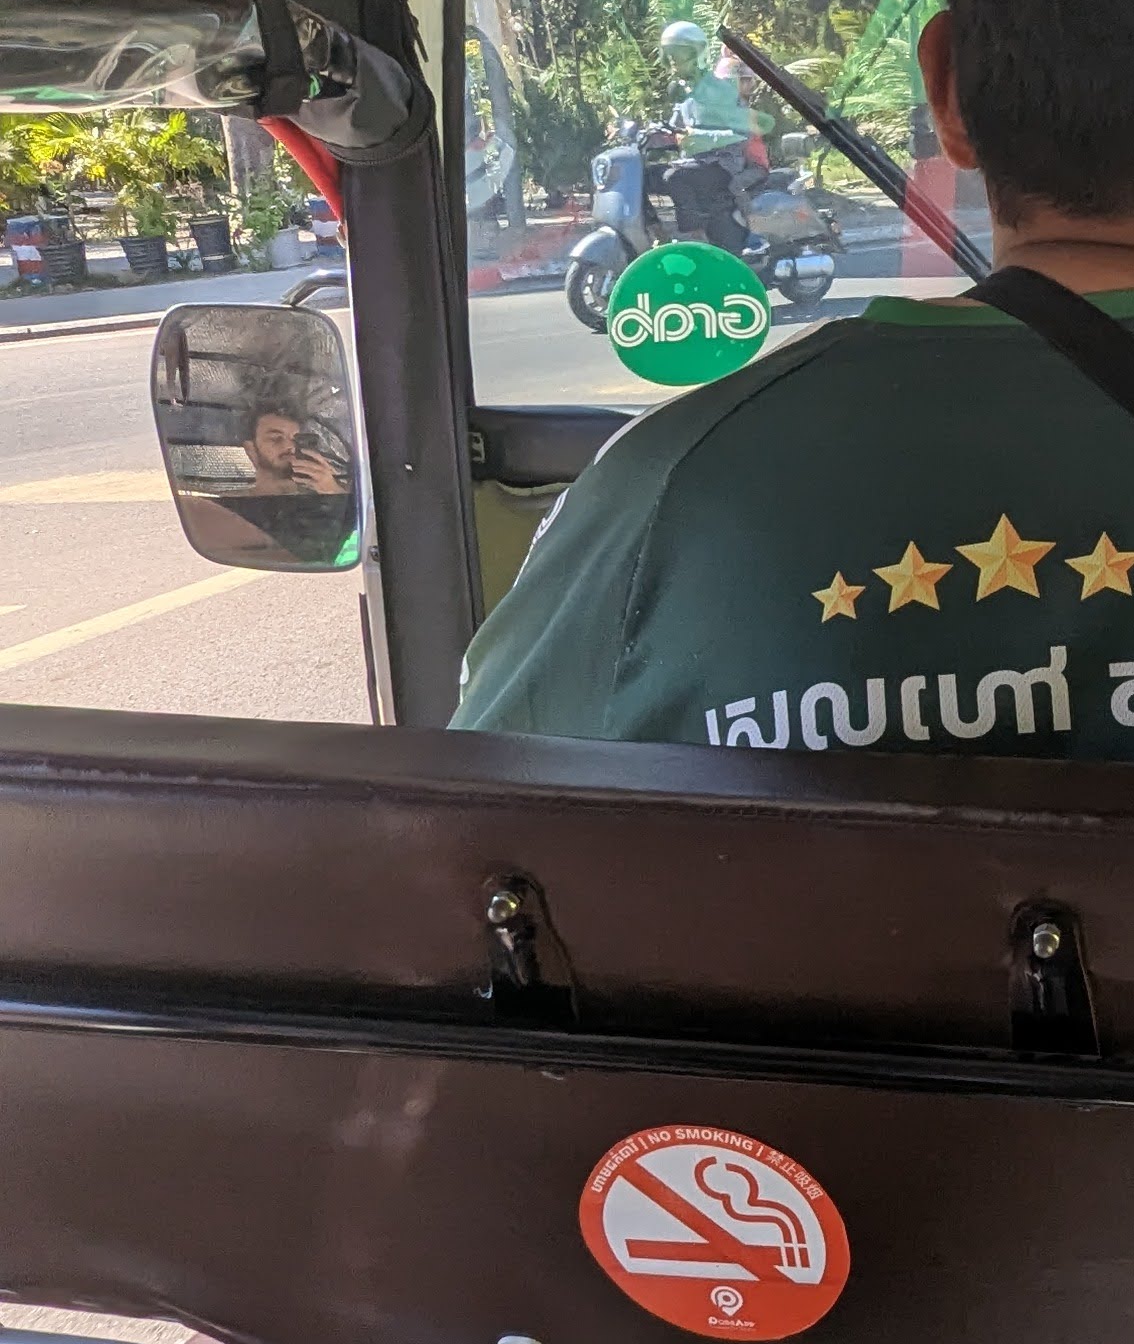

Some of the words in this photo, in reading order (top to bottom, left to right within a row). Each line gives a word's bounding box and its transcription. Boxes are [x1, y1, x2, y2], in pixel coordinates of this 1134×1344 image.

[647, 1130, 672, 1145] NO
[674, 1128, 754, 1152] SMOKING
[766, 1149, 824, 1200] 禁止吸烟
